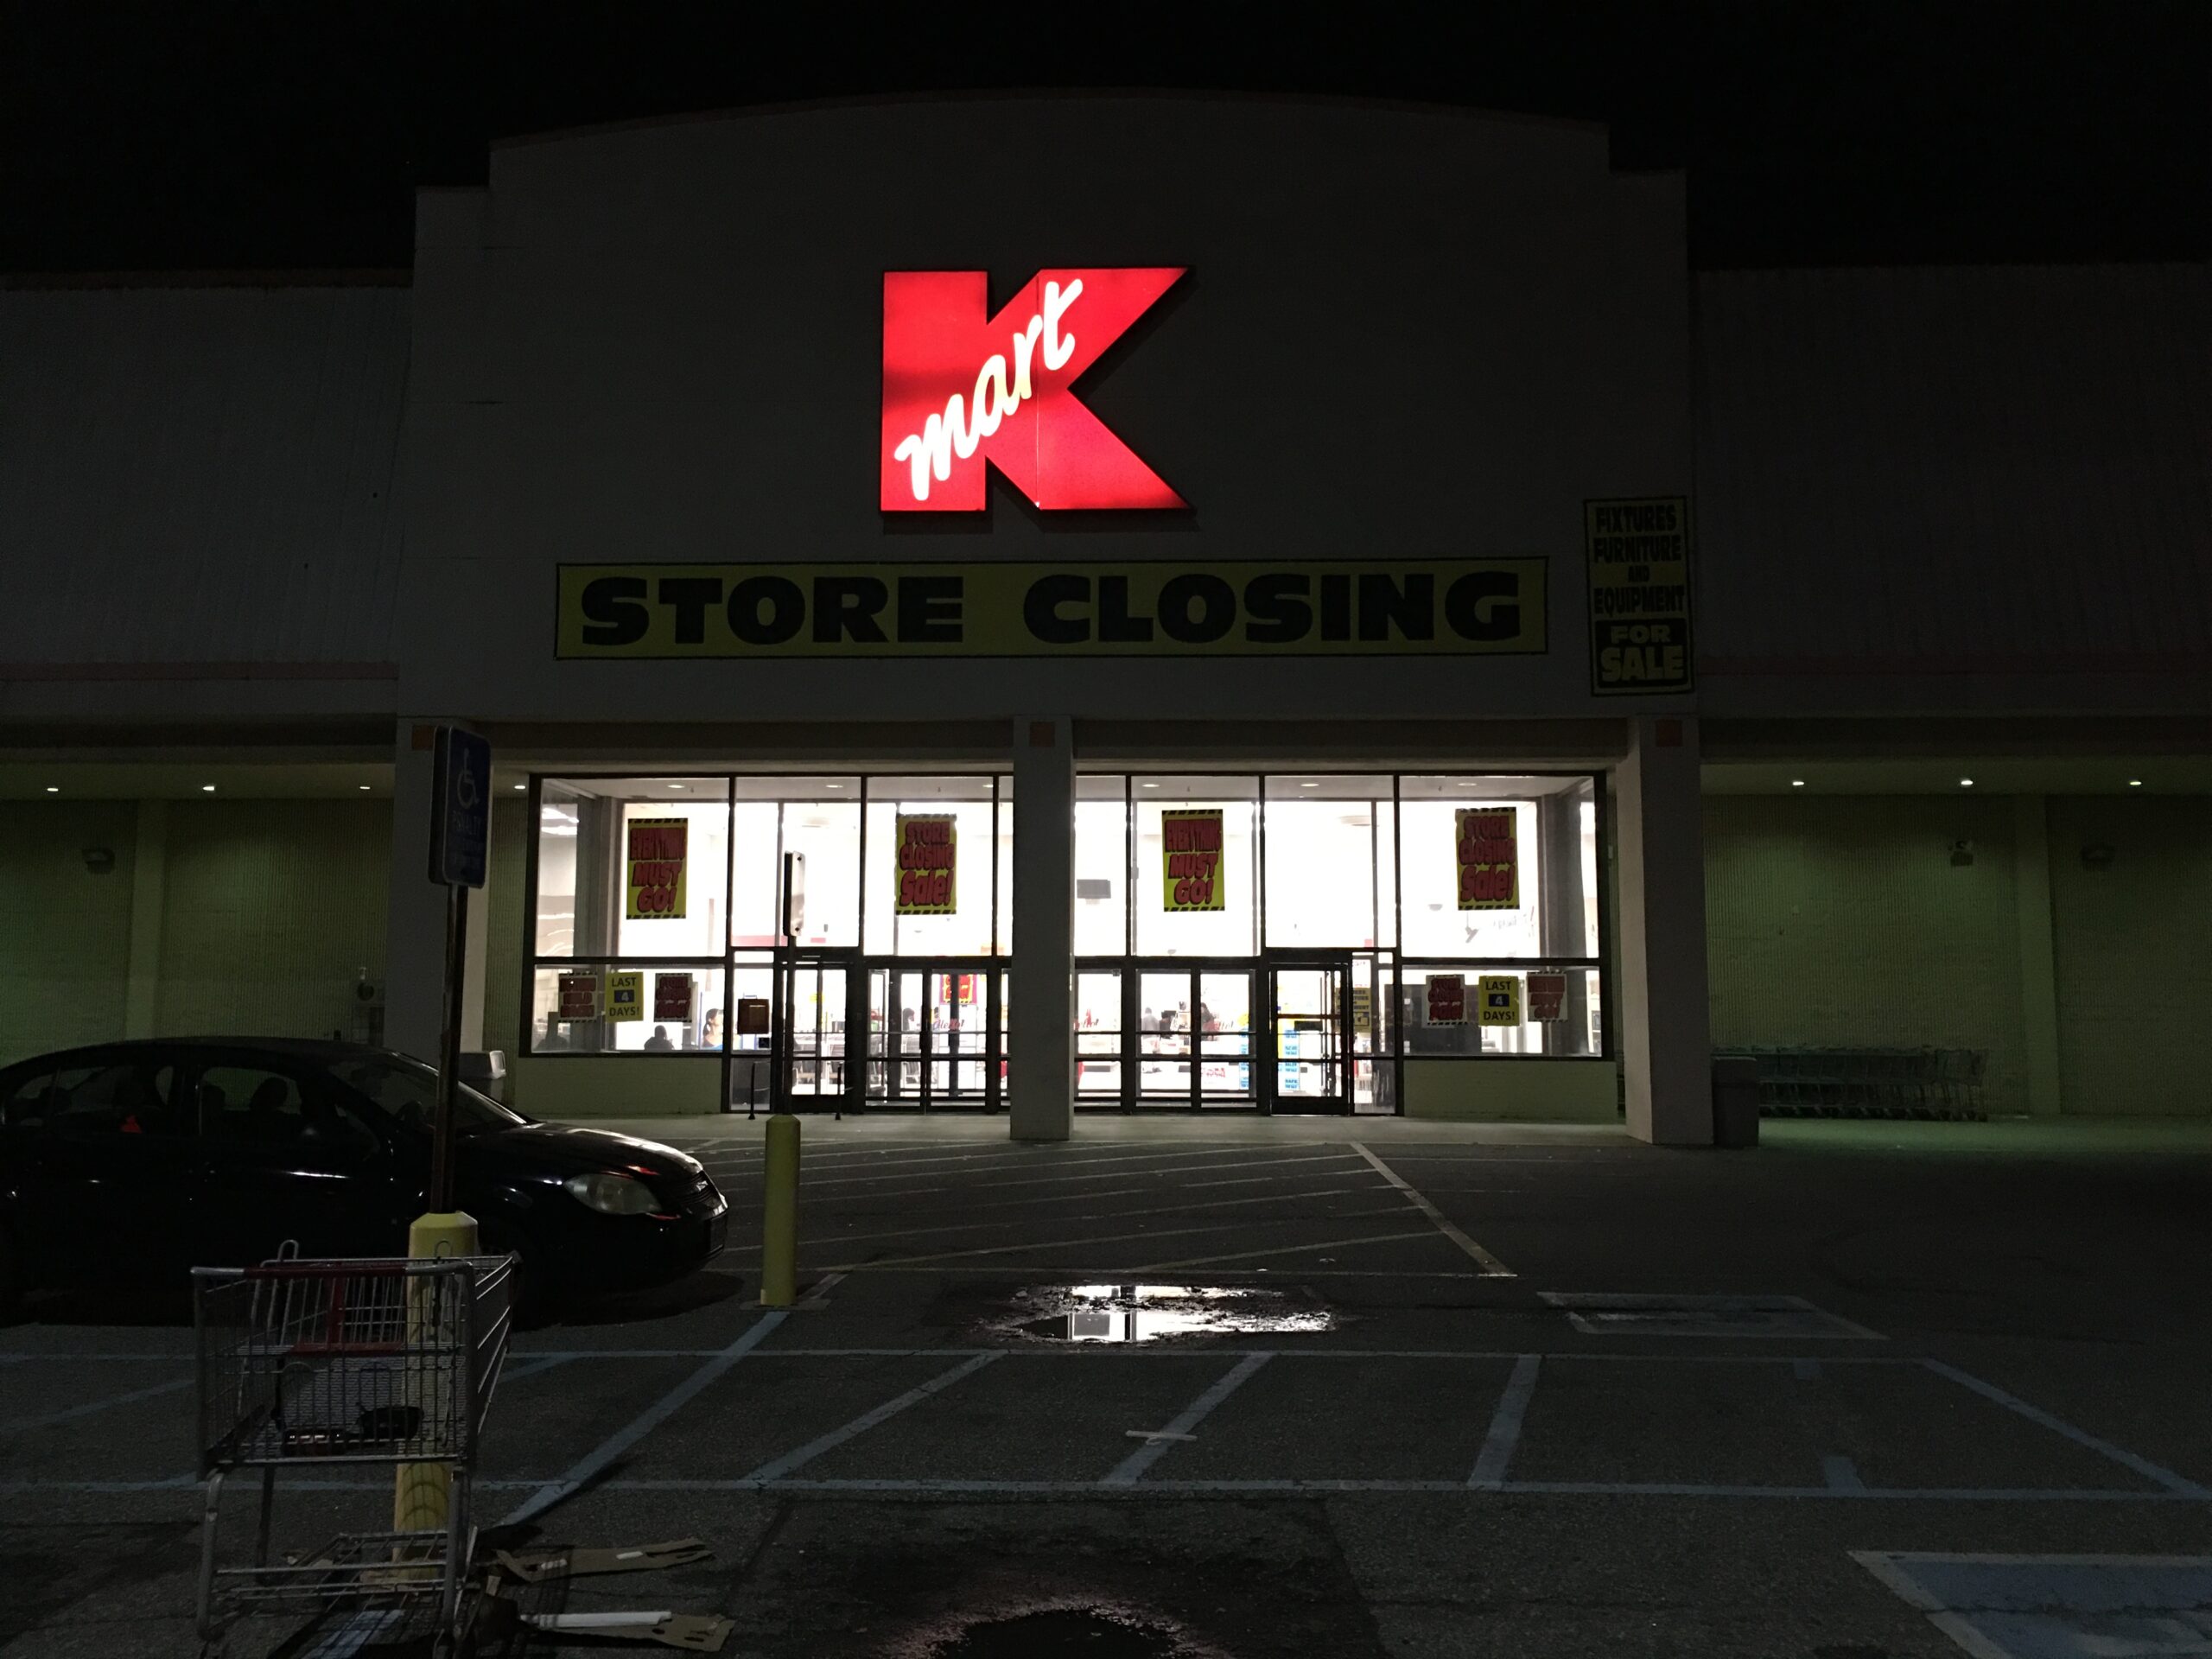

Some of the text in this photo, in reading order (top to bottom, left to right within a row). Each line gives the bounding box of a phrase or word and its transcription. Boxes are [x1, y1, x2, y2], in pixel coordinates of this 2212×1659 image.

[880, 267, 1191, 512] K mart
[1596, 505, 1676, 533] FIXTURES
[1593, 535, 1681, 563] FURNITURE
[1628, 565, 1649, 582] AND
[582, 571, 1521, 645] STORE CLOSING
[1593, 585, 1684, 617] EQUIPMENT
[1610, 624, 1672, 644] FOR
[1600, 644, 1685, 683] SALE
[906, 822, 950, 844] STORE
[899, 843, 954, 870] CLOSING
[1168, 853, 1218, 879] MUST
[632, 861, 682, 887] MUST
[637, 887, 677, 912] GO!
[1174, 879, 1213, 905] GO!
[612, 977, 636, 987] LAST
[1485, 982, 1510, 990] LAST
[609, 1007, 639, 1016] DAYS!
[1495, 996, 1503, 1005] 4
[1484, 1011, 1515, 1020] DAYS!
